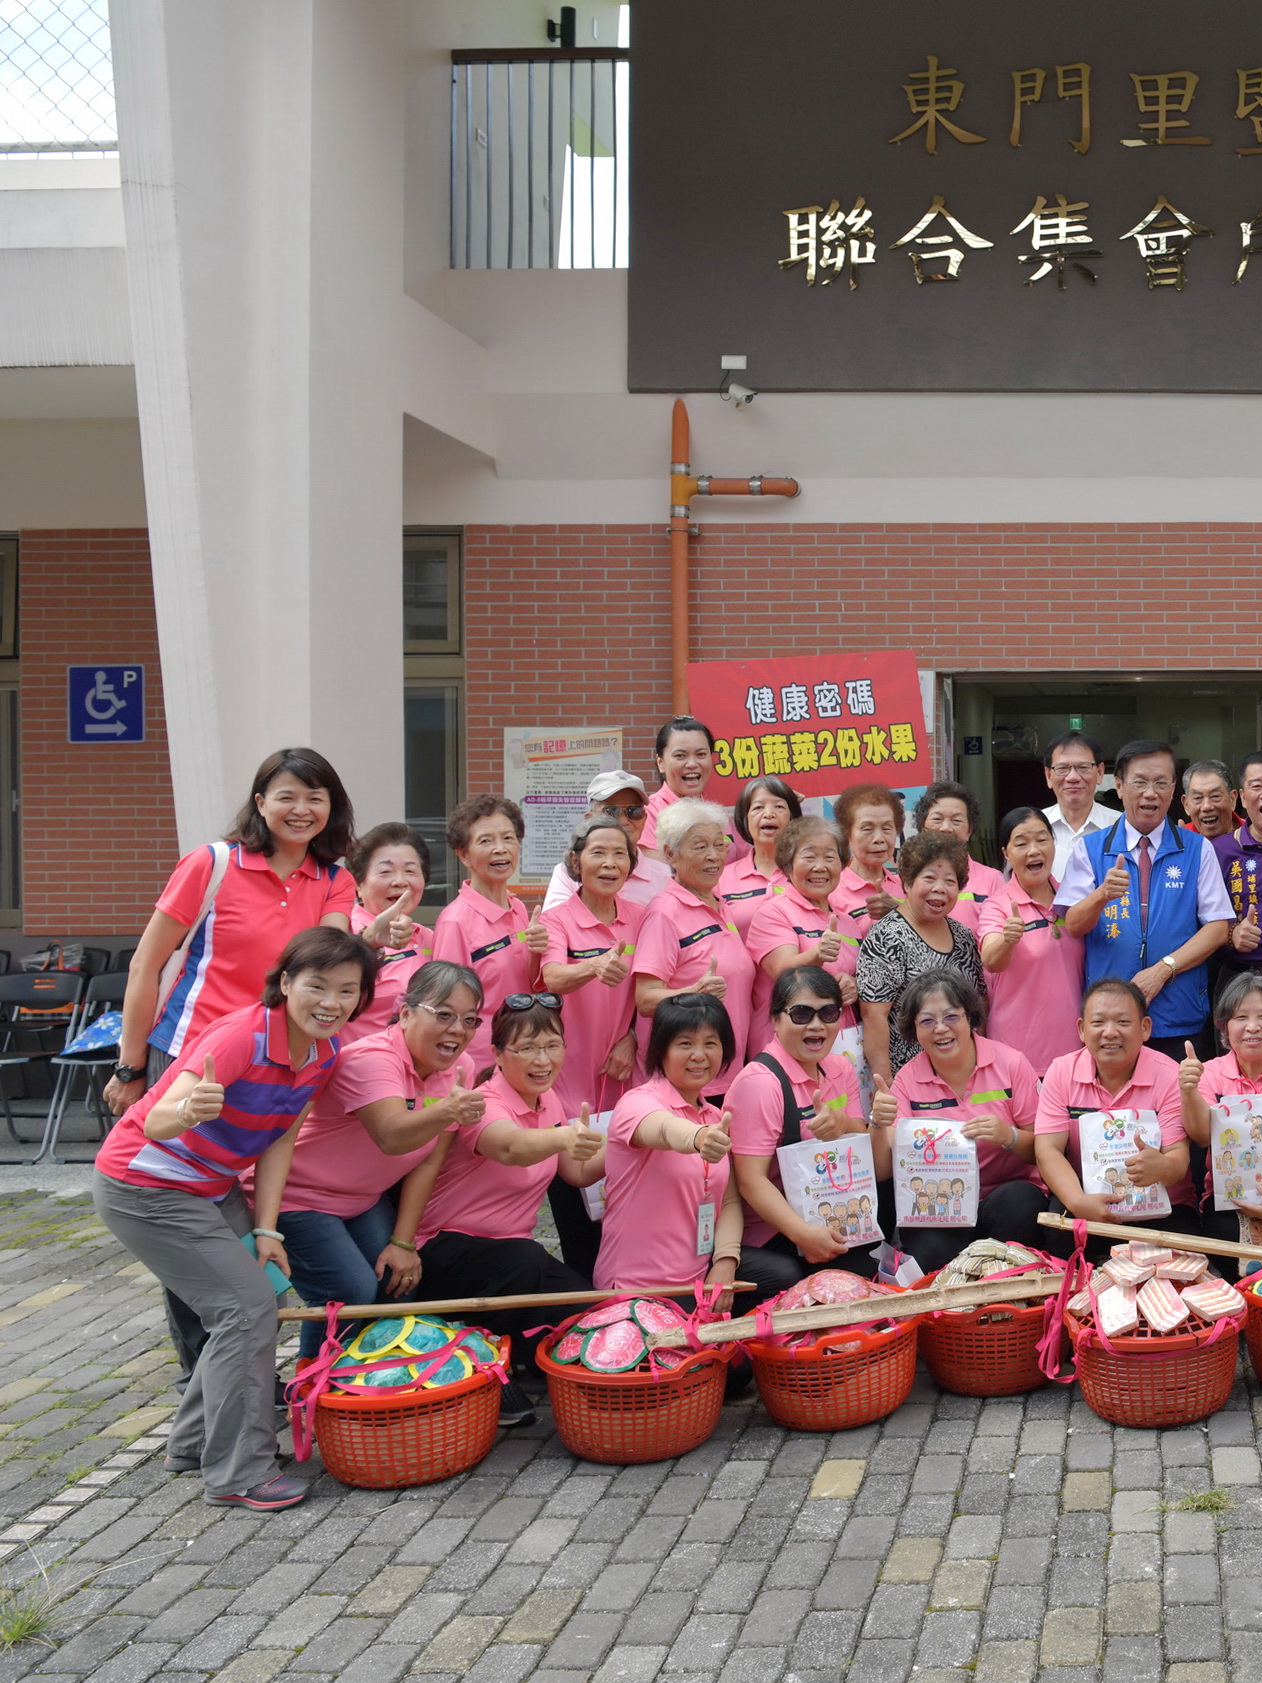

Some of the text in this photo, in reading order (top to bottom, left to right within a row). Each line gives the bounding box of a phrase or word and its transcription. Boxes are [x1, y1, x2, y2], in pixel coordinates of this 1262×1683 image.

[123, 670, 137, 688] P
[745, 678, 877, 725] 健康密碼
[714, 722, 917, 779] 3份蔬菜2份水果
